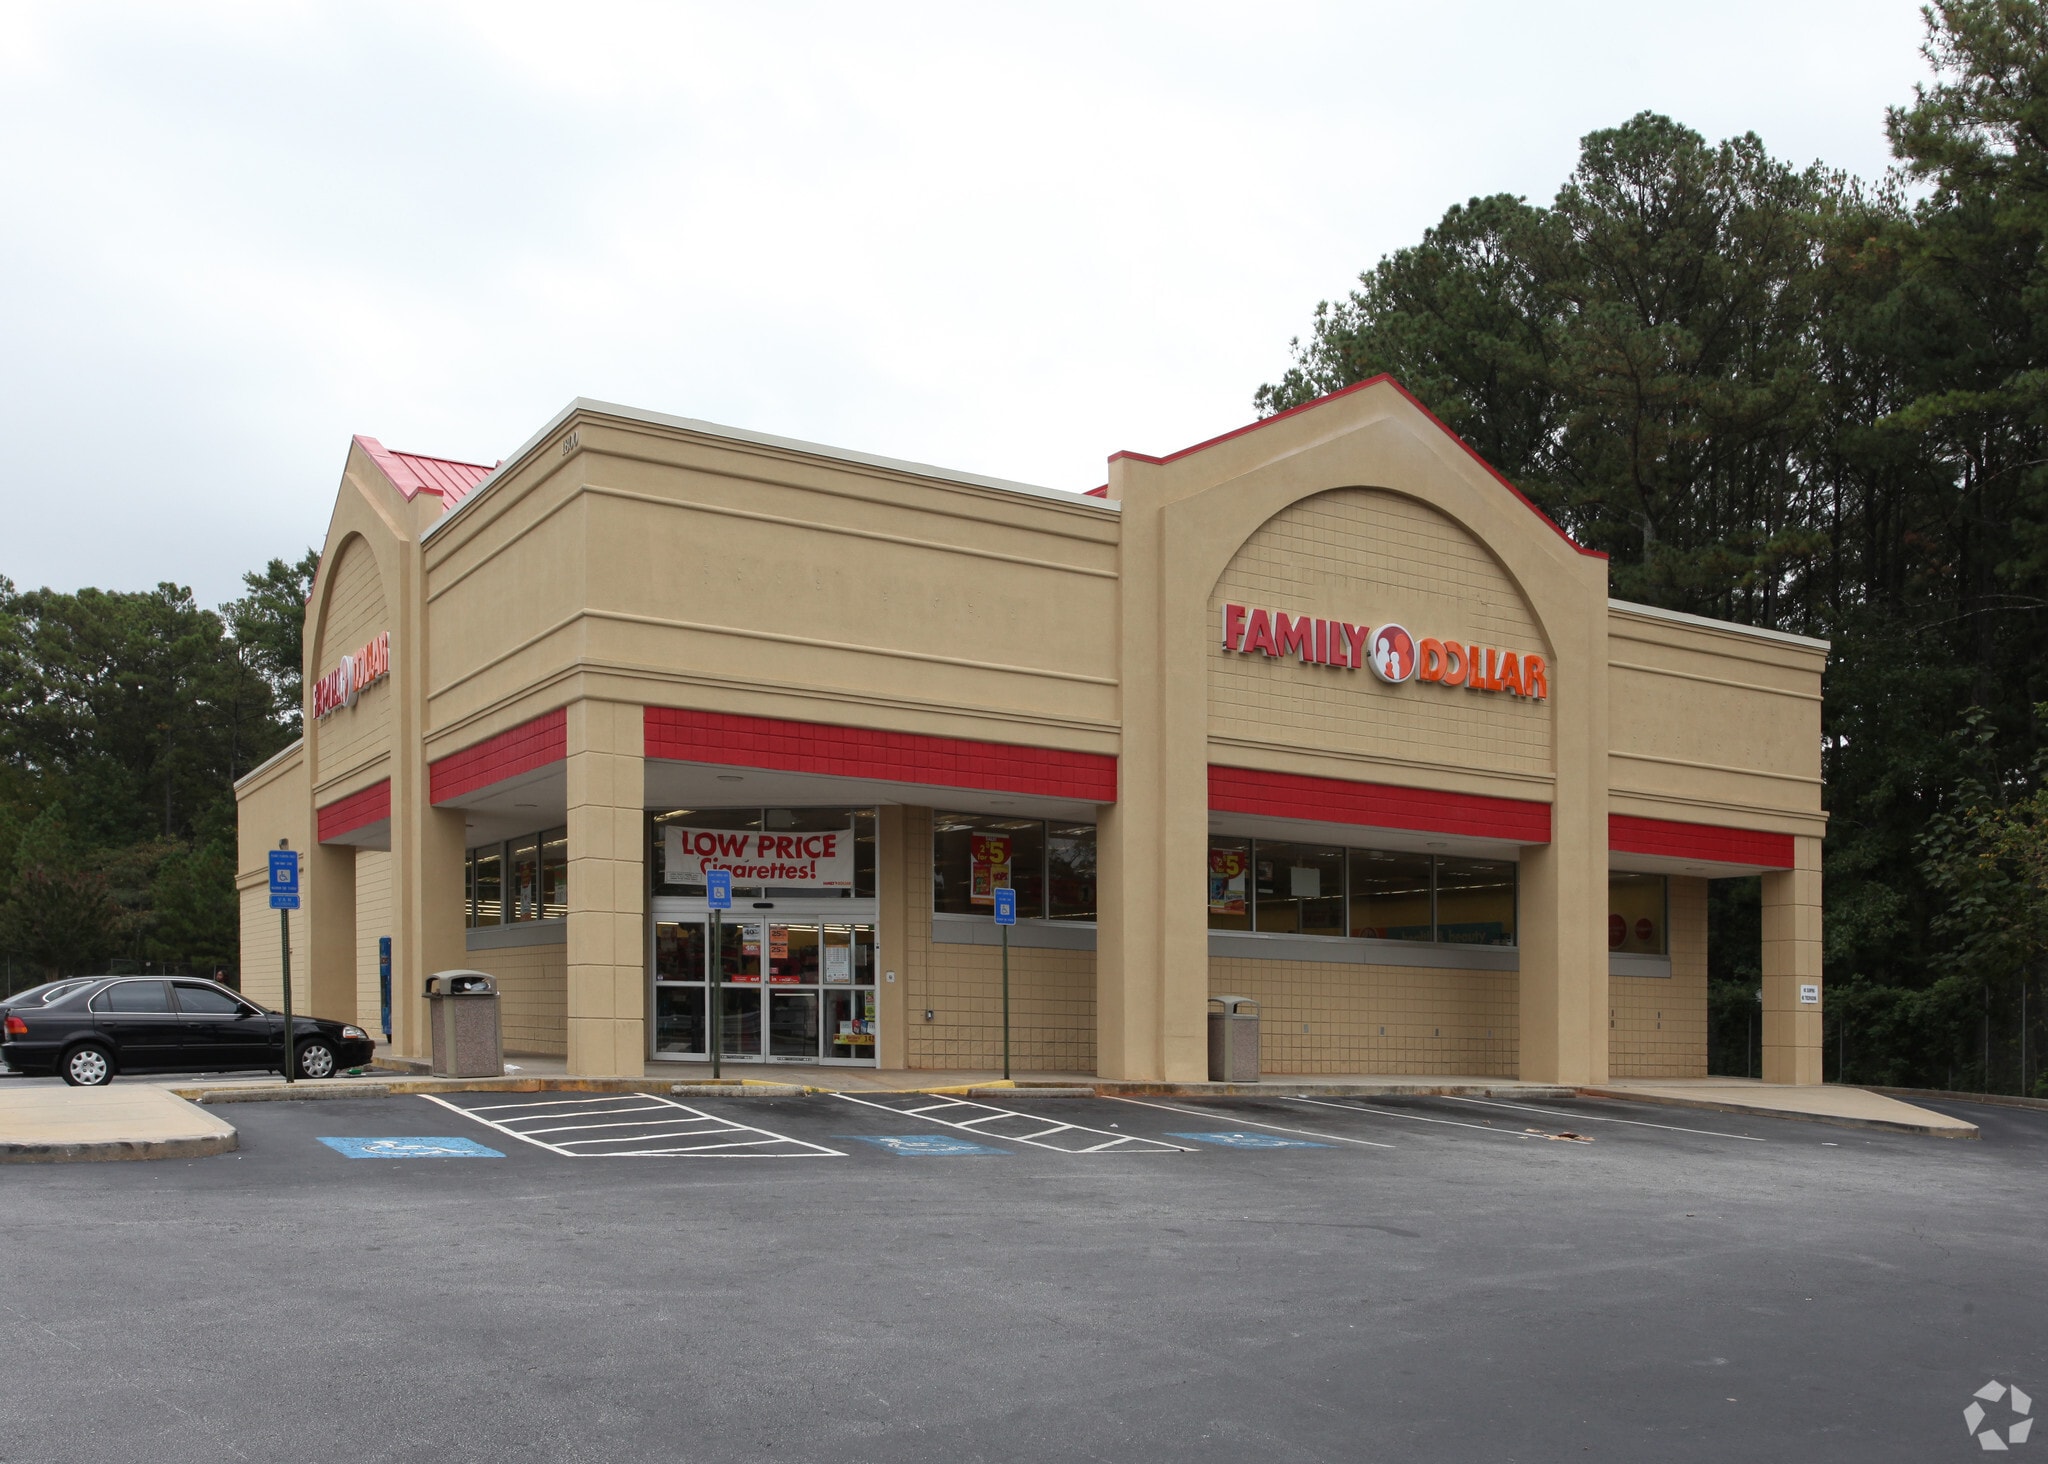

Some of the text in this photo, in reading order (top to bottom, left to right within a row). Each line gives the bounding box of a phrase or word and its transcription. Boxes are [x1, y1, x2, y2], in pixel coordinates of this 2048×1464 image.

[1222, 604, 1547, 701] FAMILY DOLLAR
[682, 831, 836, 859] LOW PRICE
